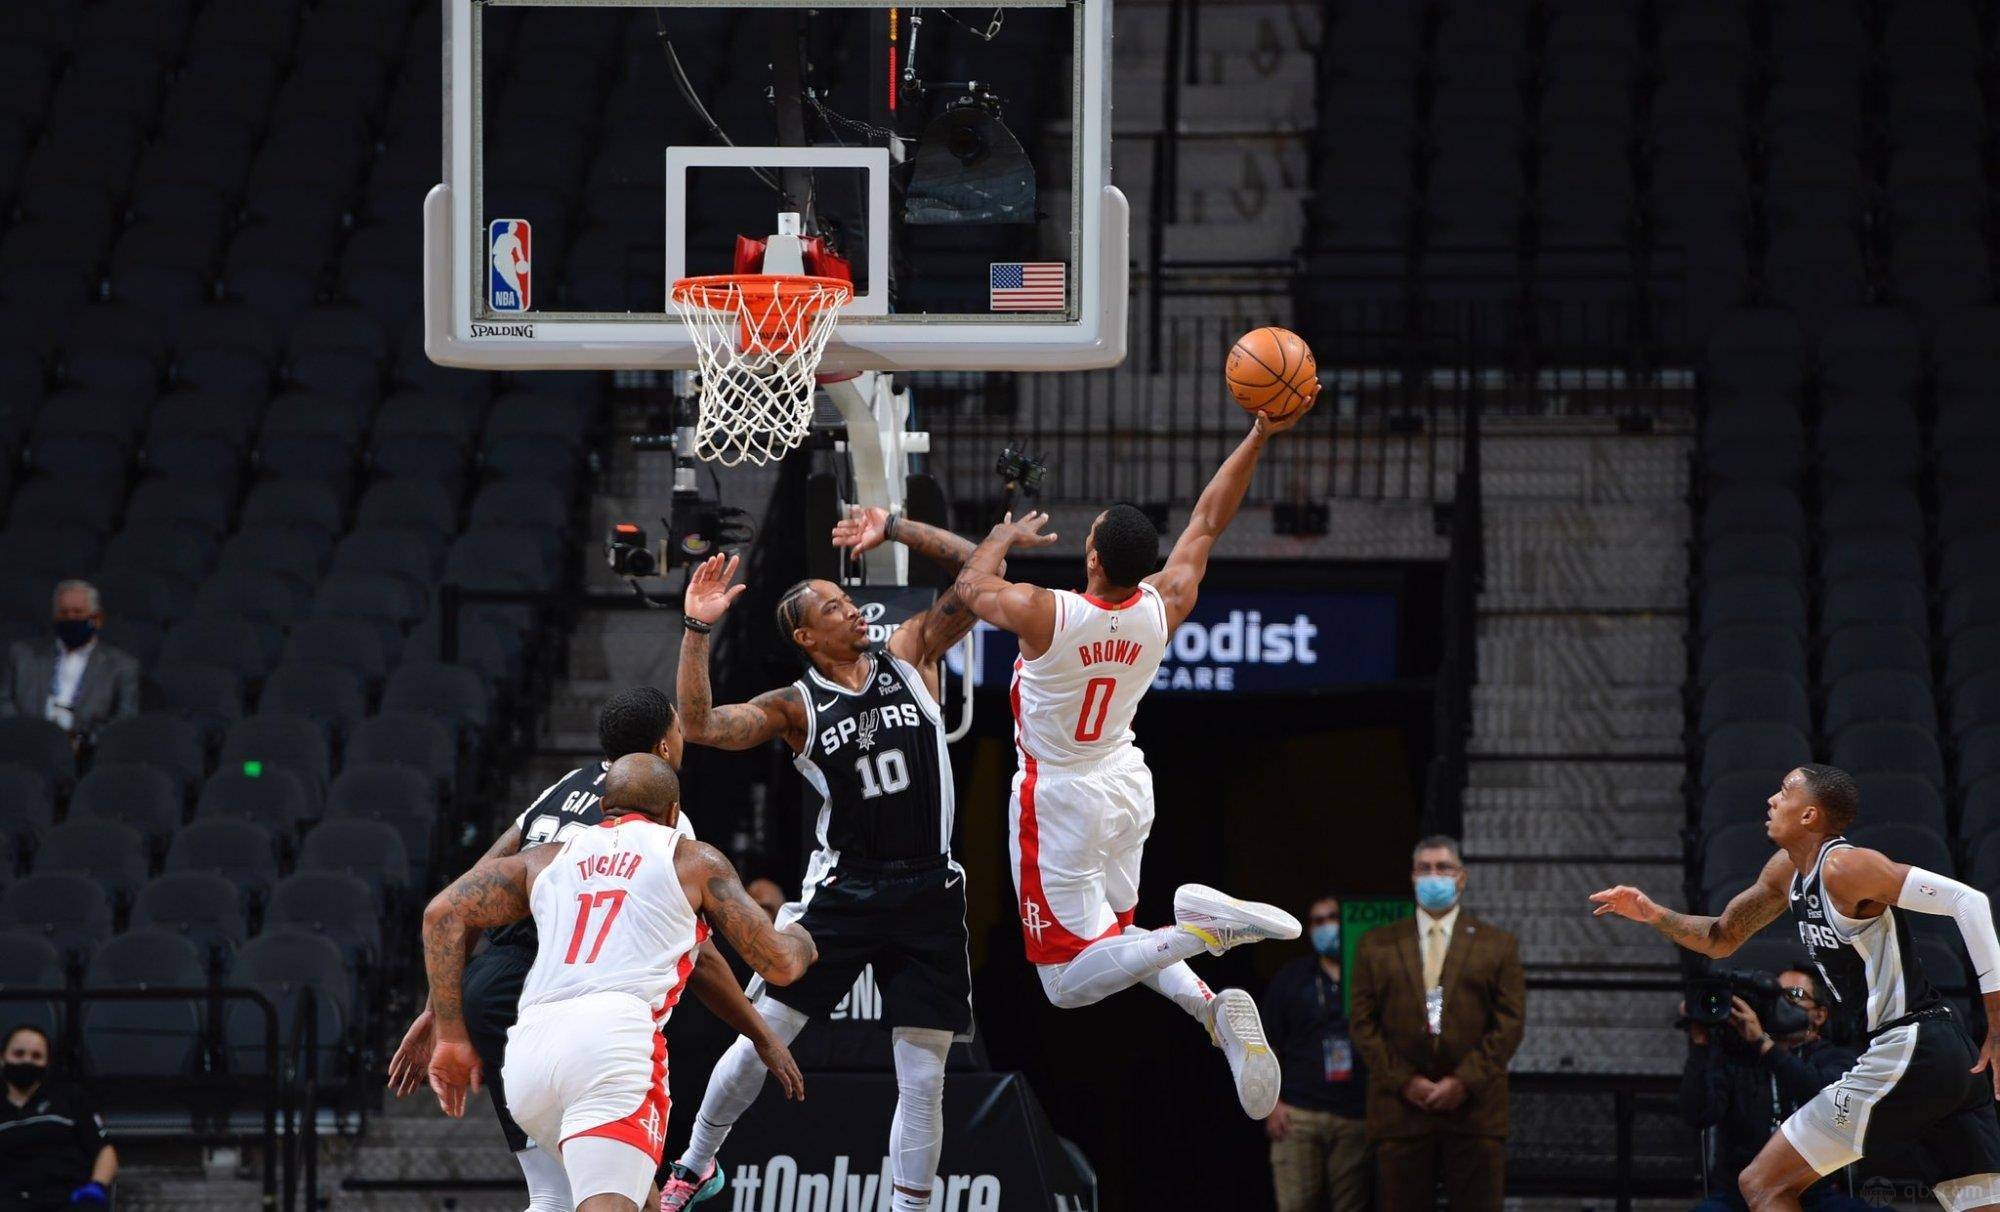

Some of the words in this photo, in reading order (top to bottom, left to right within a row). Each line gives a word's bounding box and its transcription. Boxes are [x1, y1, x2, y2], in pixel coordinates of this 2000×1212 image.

[495, 290, 516, 307] NBA
[470, 324, 534, 339] SPALDING
[1079, 639, 1143, 667] BROWN
[1151, 666, 1235, 691] CARE
[1074, 677, 1117, 743] 0
[820, 702, 921, 757] SPURS
[855, 748, 911, 800] 10
[561, 790, 600, 816] GAY
[576, 851, 643, 881] TUCKER
[563, 888, 630, 965] 17
[731, 1154, 1001, 1212] #Onlyre
